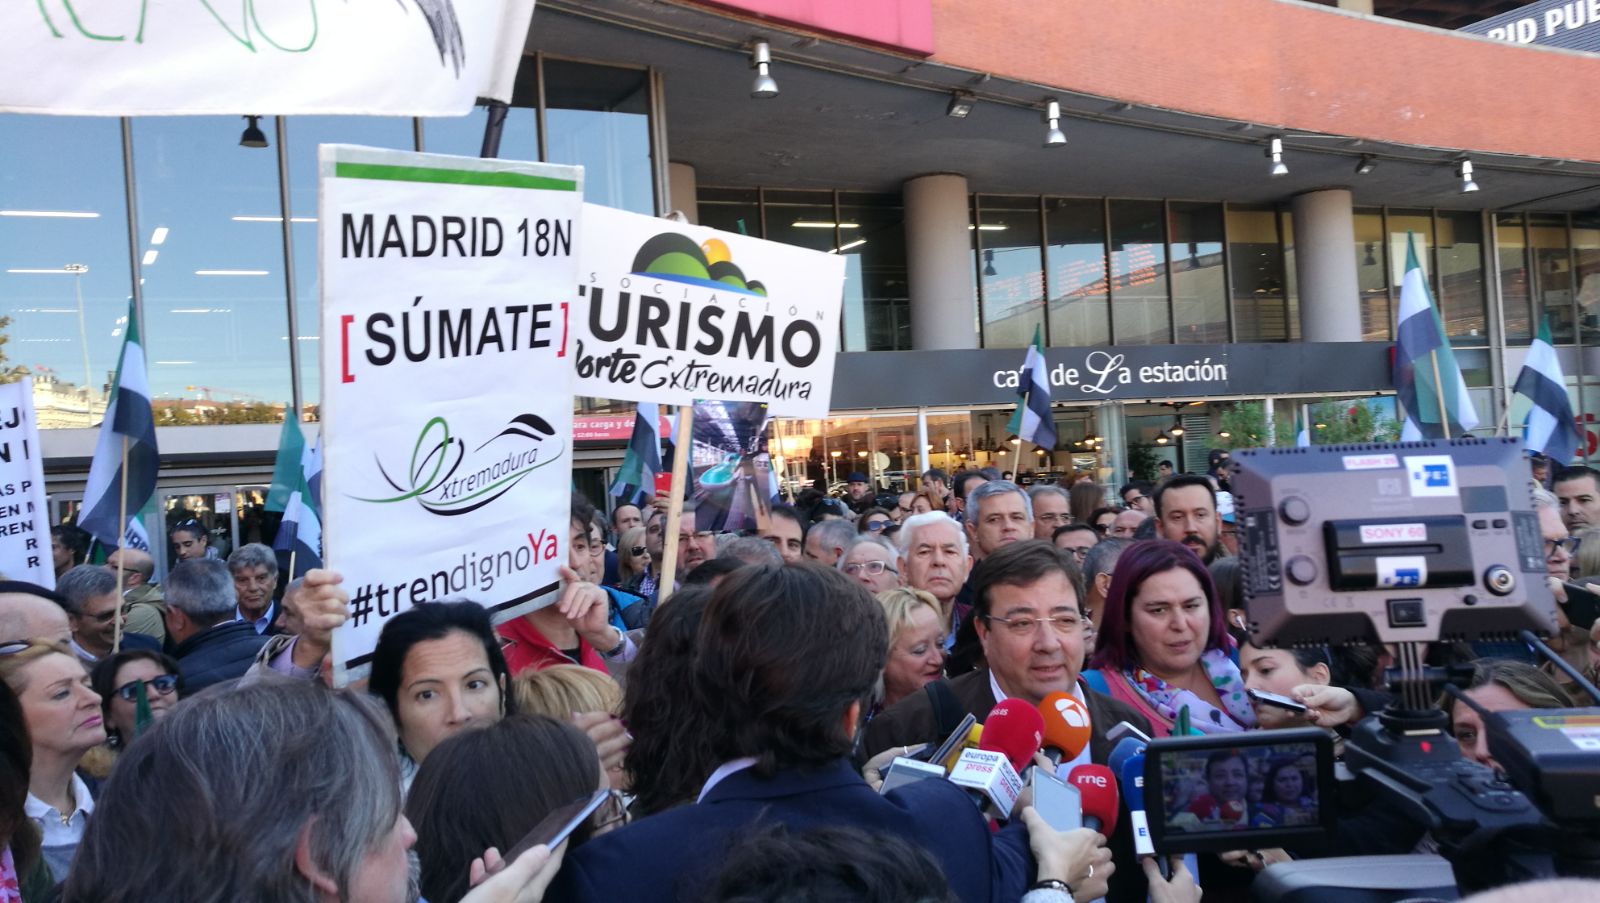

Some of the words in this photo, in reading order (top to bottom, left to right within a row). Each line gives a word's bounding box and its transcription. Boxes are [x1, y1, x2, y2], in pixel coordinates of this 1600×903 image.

[341, 213, 504, 258] MADRID
[517, 217, 571, 257] 18N
[589, 272, 824, 321] SOCIACIÓN
[578, 284, 821, 368] URISMO
[641, 355, 812, 400] Extremadura
[1050, 362, 1079, 386] de
[1080, 351, 1131, 394] La
[1138, 358, 1227, 383] estación
[589, 420, 614, 430] carga
[624, 419, 635, 427] de
[1365, 528, 1403, 539] SONY
[26, 537, 38, 551] R
[28, 556, 40, 569] R
[965, 751, 999, 762] europa
[965, 763, 993, 774] press
[1077, 775, 1108, 788] rne
